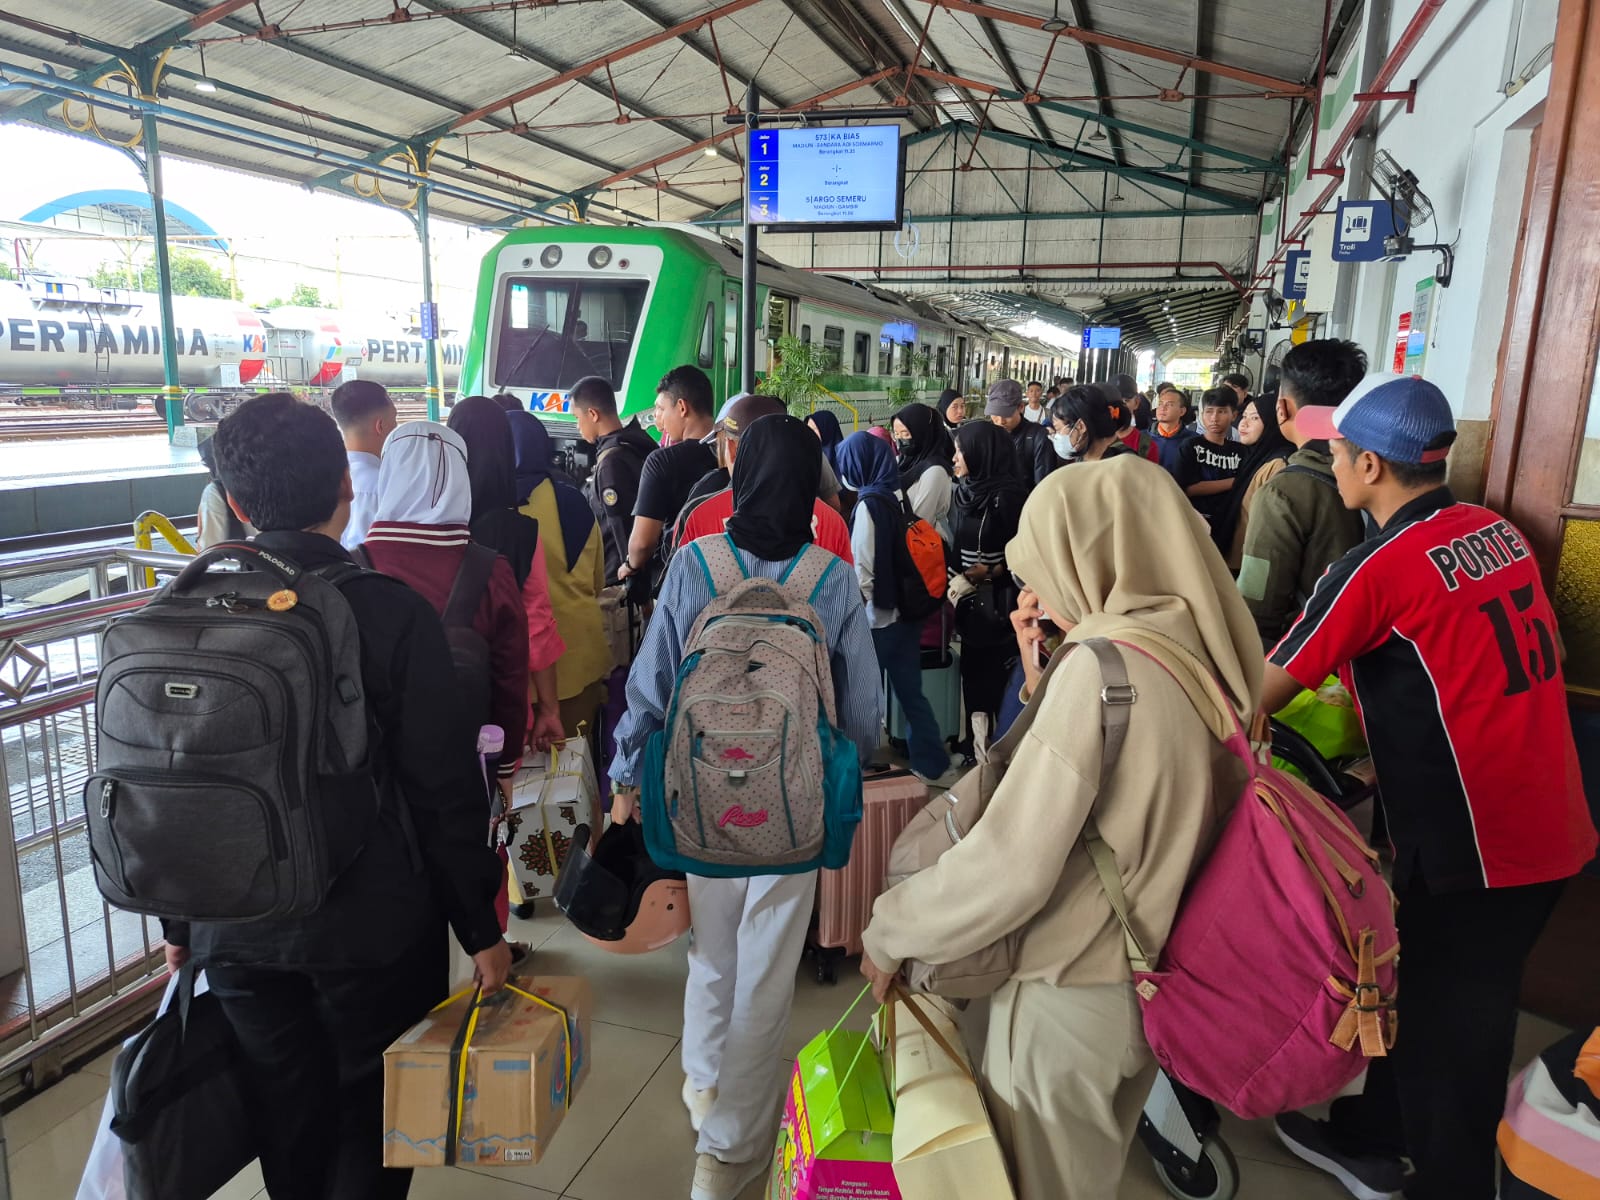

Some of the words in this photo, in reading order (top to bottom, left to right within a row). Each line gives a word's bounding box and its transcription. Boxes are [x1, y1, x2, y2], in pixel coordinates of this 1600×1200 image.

[843, 132, 860, 140] BIAS
[761, 142, 767, 155] 1
[760, 173, 769, 186] 2
[836, 194, 867, 203] SEMERU
[760, 203, 768, 217] 3
[1340, 243, 1356, 251] Troli
[0, 317, 209, 356] ERTAMIA
[1425, 519, 1530, 592] PORTE
[1478, 581, 1557, 697] 15
